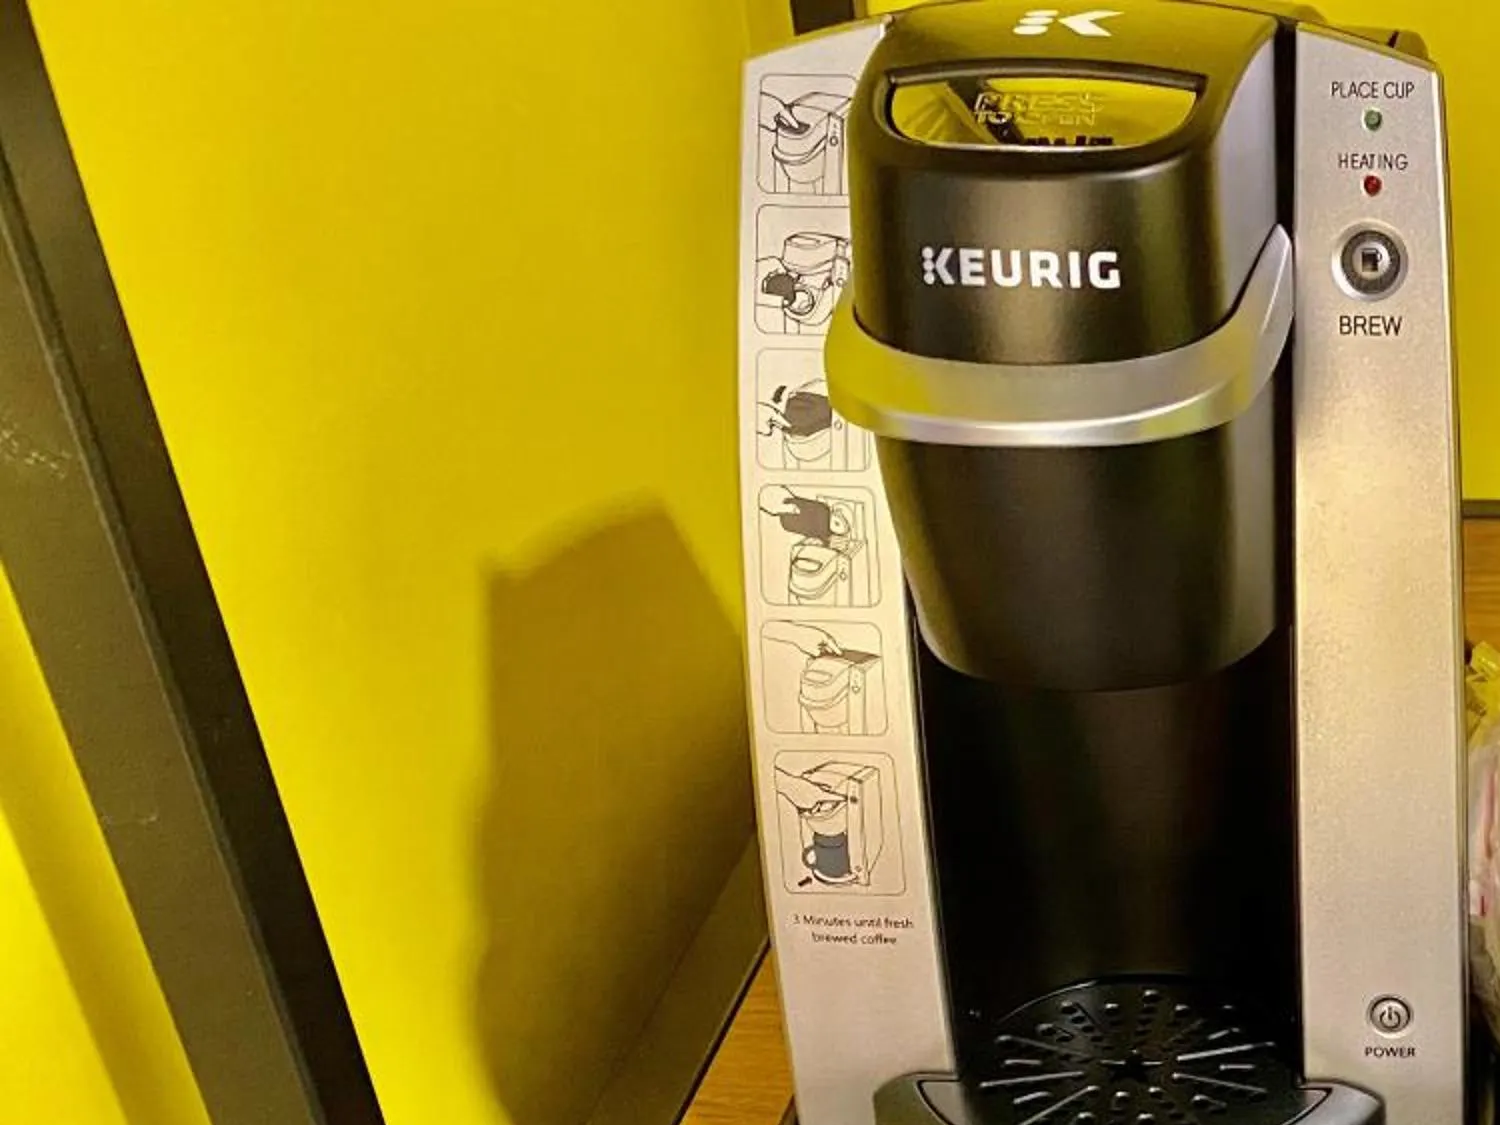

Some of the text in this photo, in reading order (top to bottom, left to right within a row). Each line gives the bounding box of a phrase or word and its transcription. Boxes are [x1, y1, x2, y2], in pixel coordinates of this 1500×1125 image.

[1331, 81, 1415, 99] PLACE CUP
[1337, 152, 1409, 171] HEATING
[921, 246, 1121, 290] KEURIG
[1339, 315, 1402, 336] BREW
[803, 915, 852, 927] Minutes
[853, 917, 882, 928] until
[883, 917, 914, 928] fresh
[811, 932, 897, 944] brewed coffee
[1364, 1047, 1416, 1058] POWER
